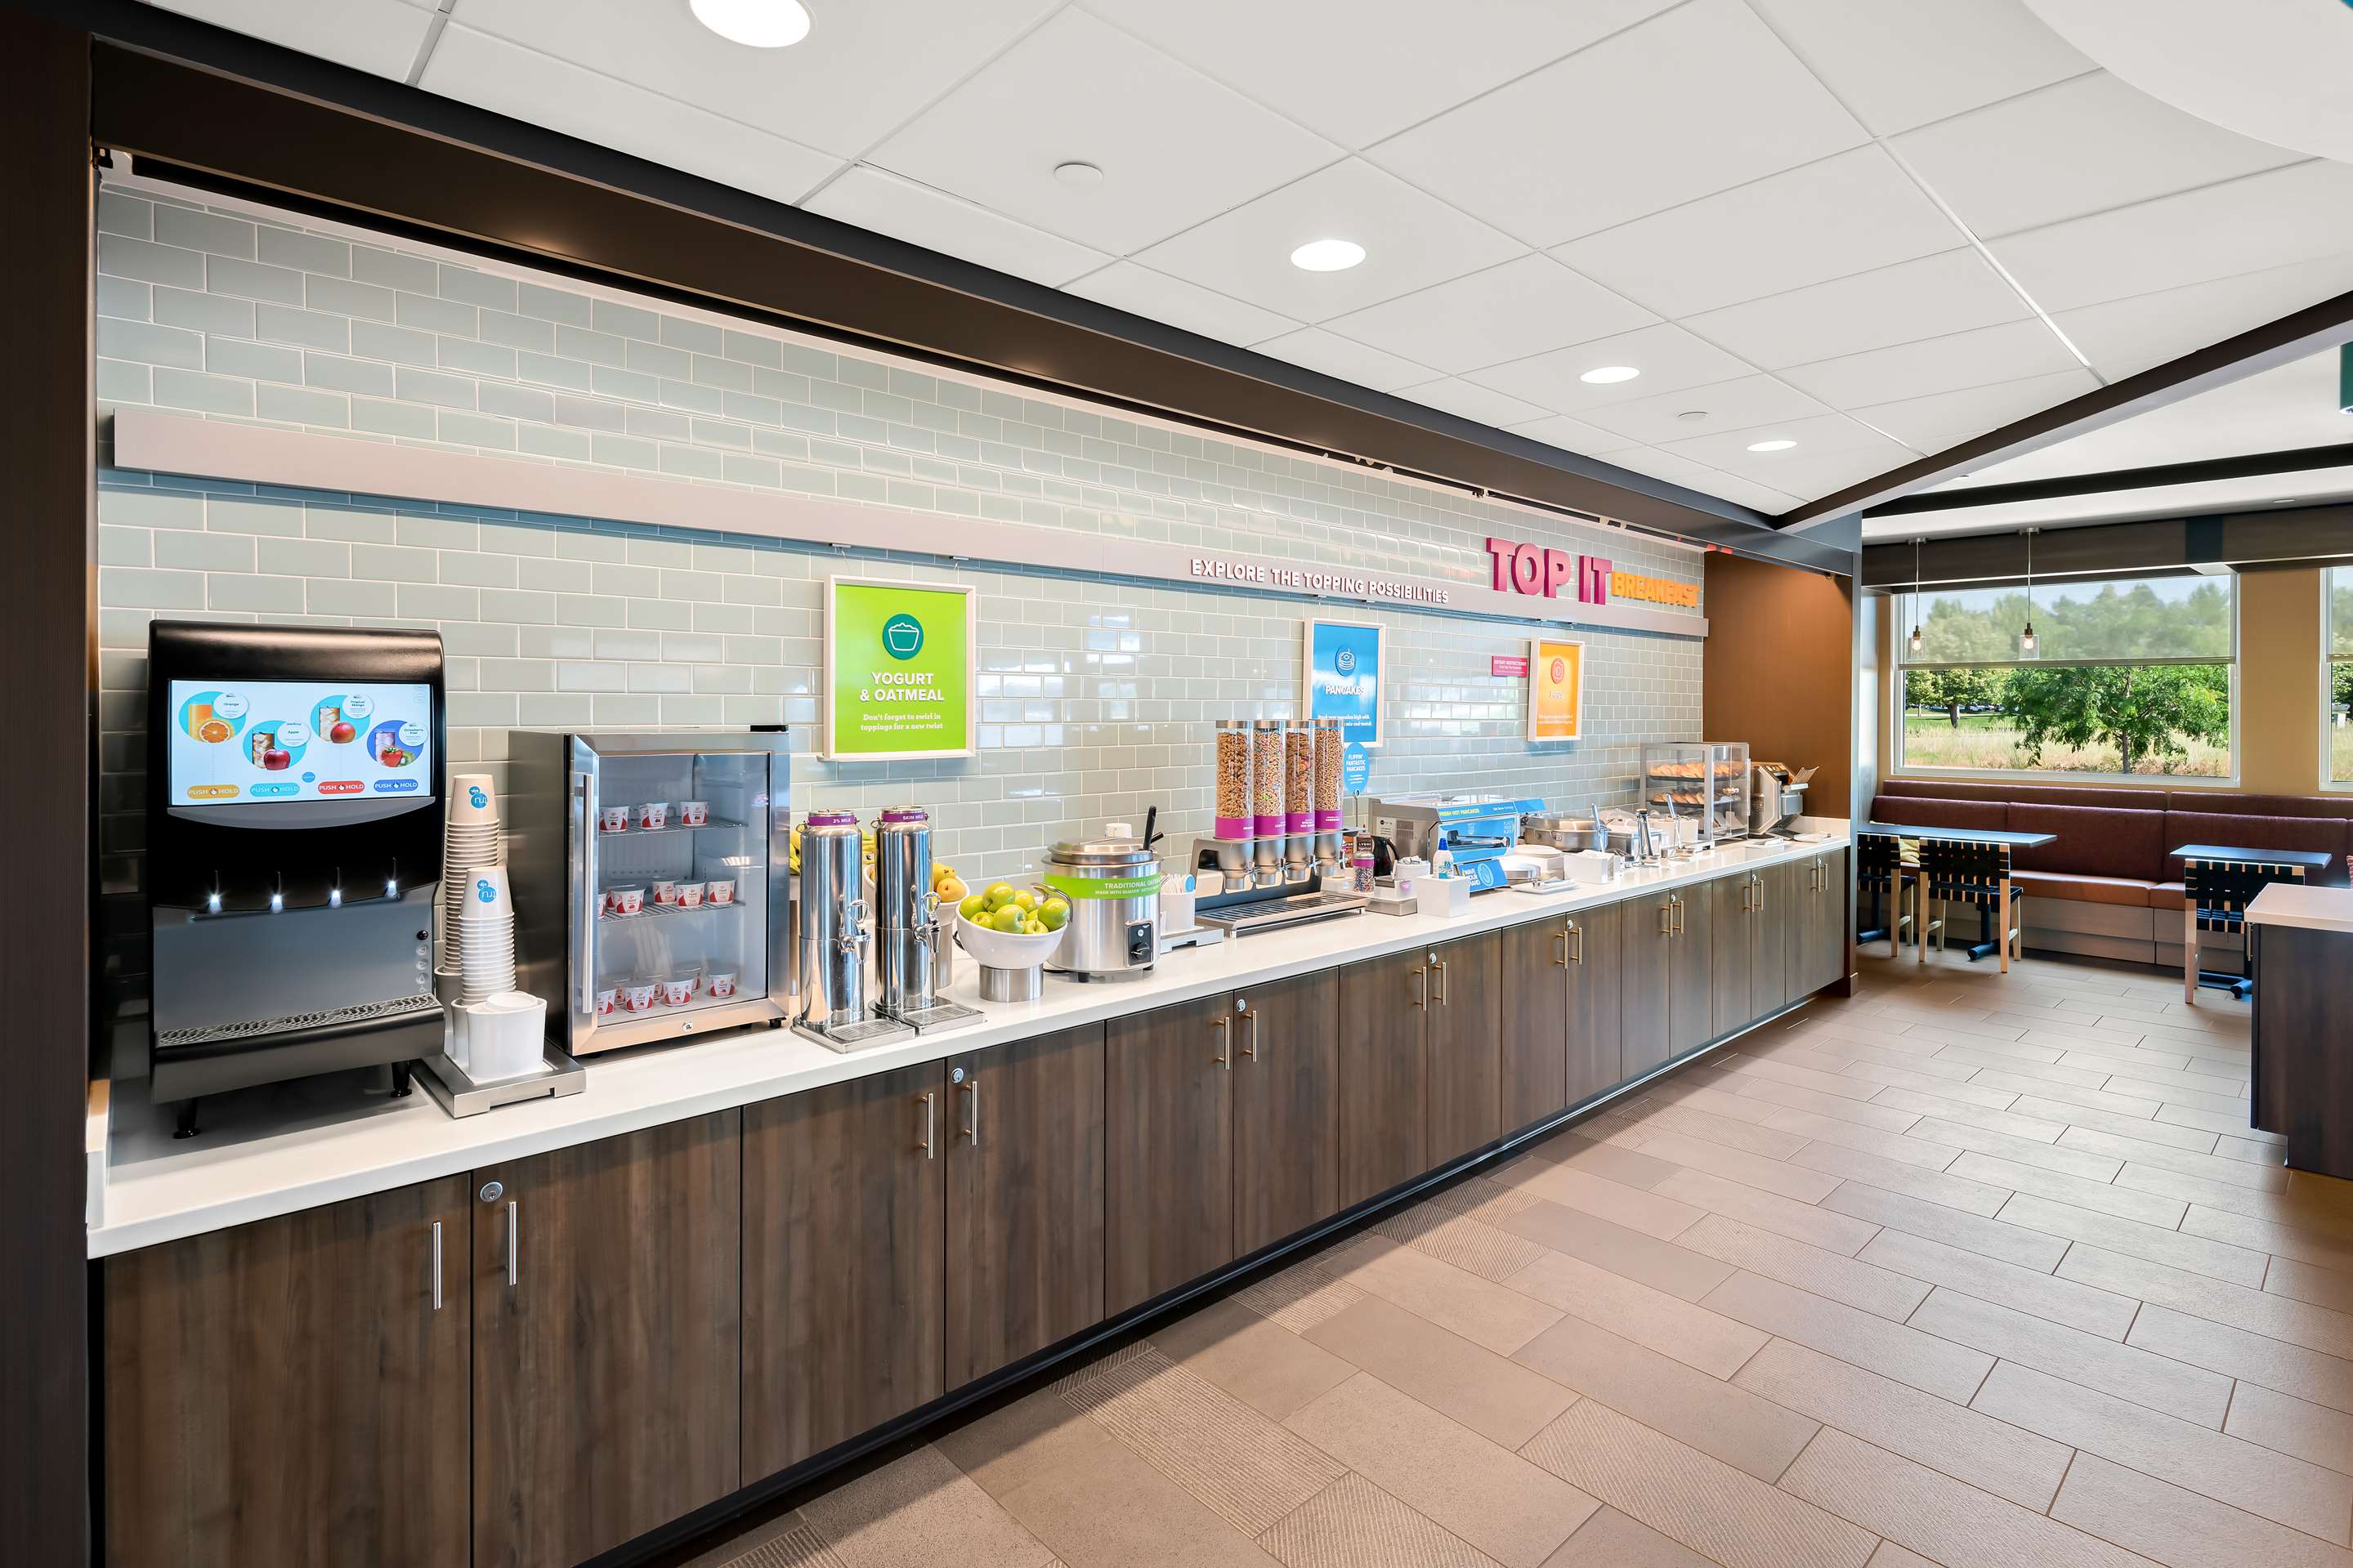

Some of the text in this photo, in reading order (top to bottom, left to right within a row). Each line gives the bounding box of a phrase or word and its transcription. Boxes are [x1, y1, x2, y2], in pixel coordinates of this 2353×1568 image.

[1486, 537, 1613, 605] TOP IT
[1191, 559, 1449, 603] EXPLORE THE TOPPING POSSIBILITIES
[1611, 570, 1701, 608] BREAKFAST
[871, 672, 934, 686] YOGURT
[860, 689, 945, 702] & OATMEAL
[1325, 685, 1365, 695] PANCAKES
[884, 713, 906, 721] forget
[861, 724, 892, 732] toppings
